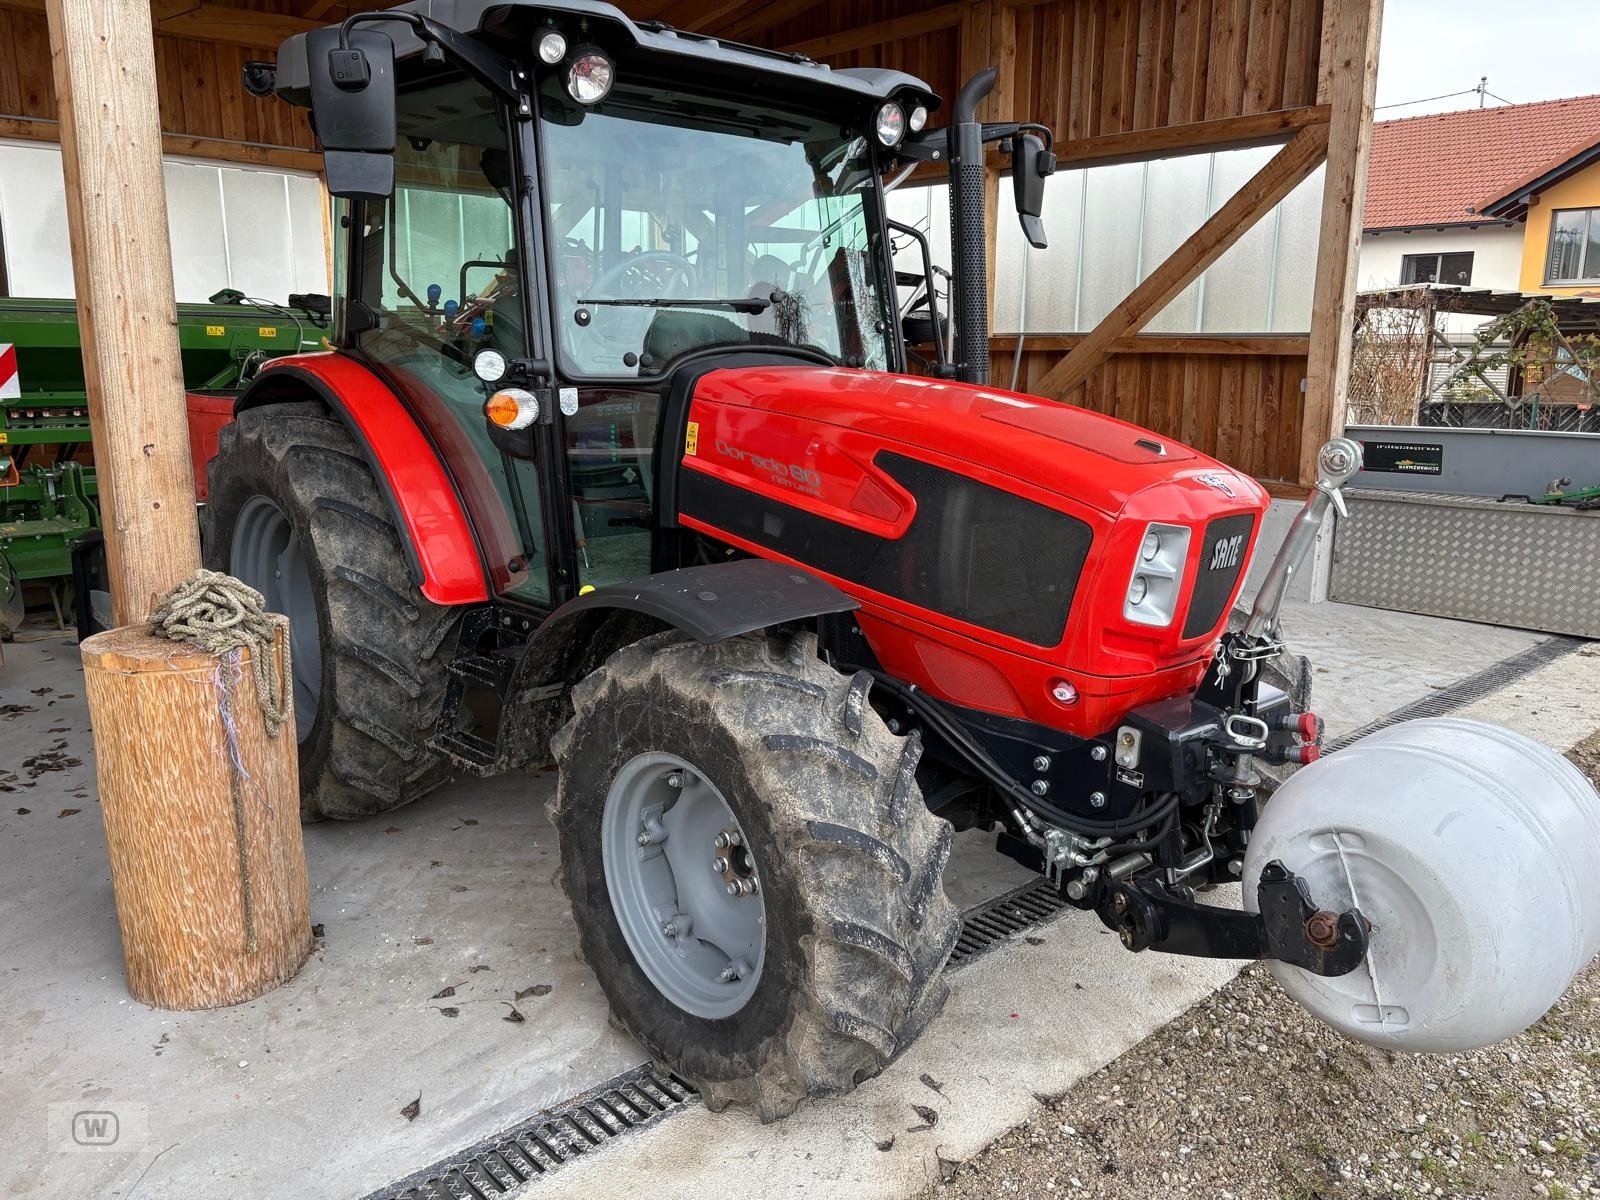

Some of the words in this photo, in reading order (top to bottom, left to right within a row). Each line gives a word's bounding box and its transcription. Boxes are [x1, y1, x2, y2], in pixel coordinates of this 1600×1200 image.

[714, 438, 788, 476] Dorado
[790, 463, 822, 488] 80
[1209, 534, 1243, 571] SAME
